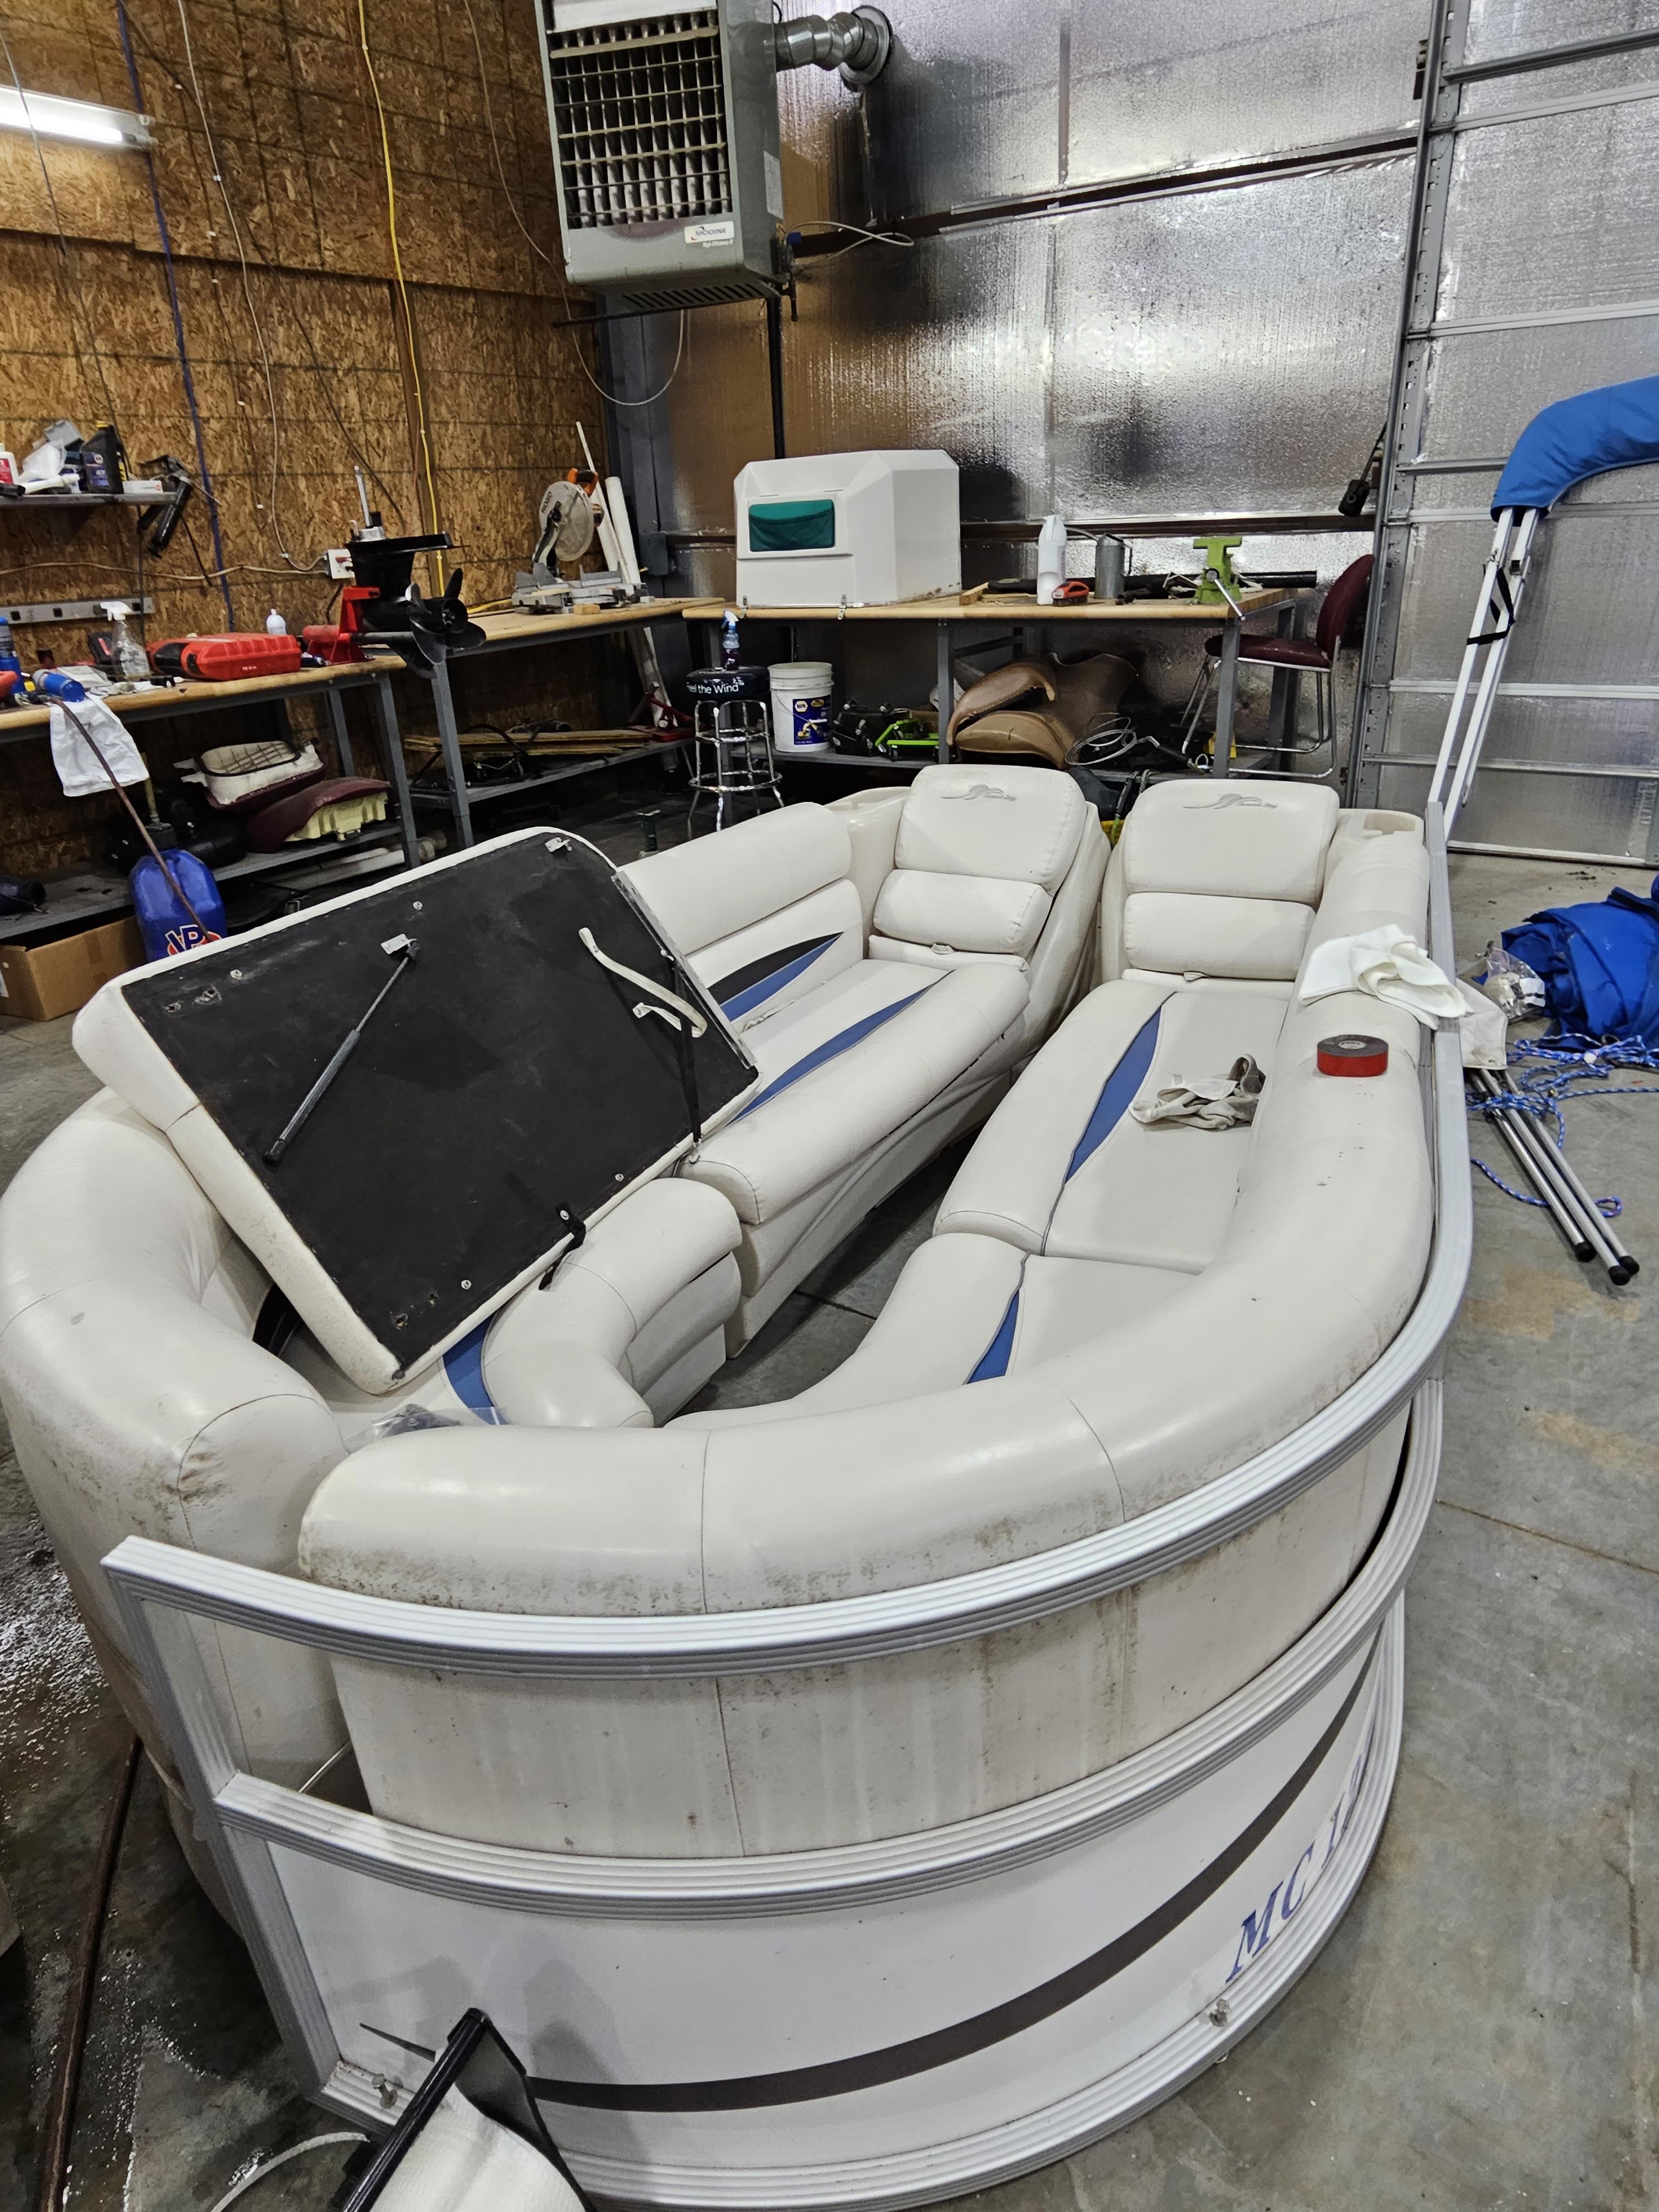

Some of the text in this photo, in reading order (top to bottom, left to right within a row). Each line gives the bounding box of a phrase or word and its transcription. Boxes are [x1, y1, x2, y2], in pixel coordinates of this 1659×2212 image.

[695, 228, 727, 237] MODINE
[698, 684, 712, 694] the
[713, 682, 739, 693] Wind
[165, 925, 205, 953] VP
